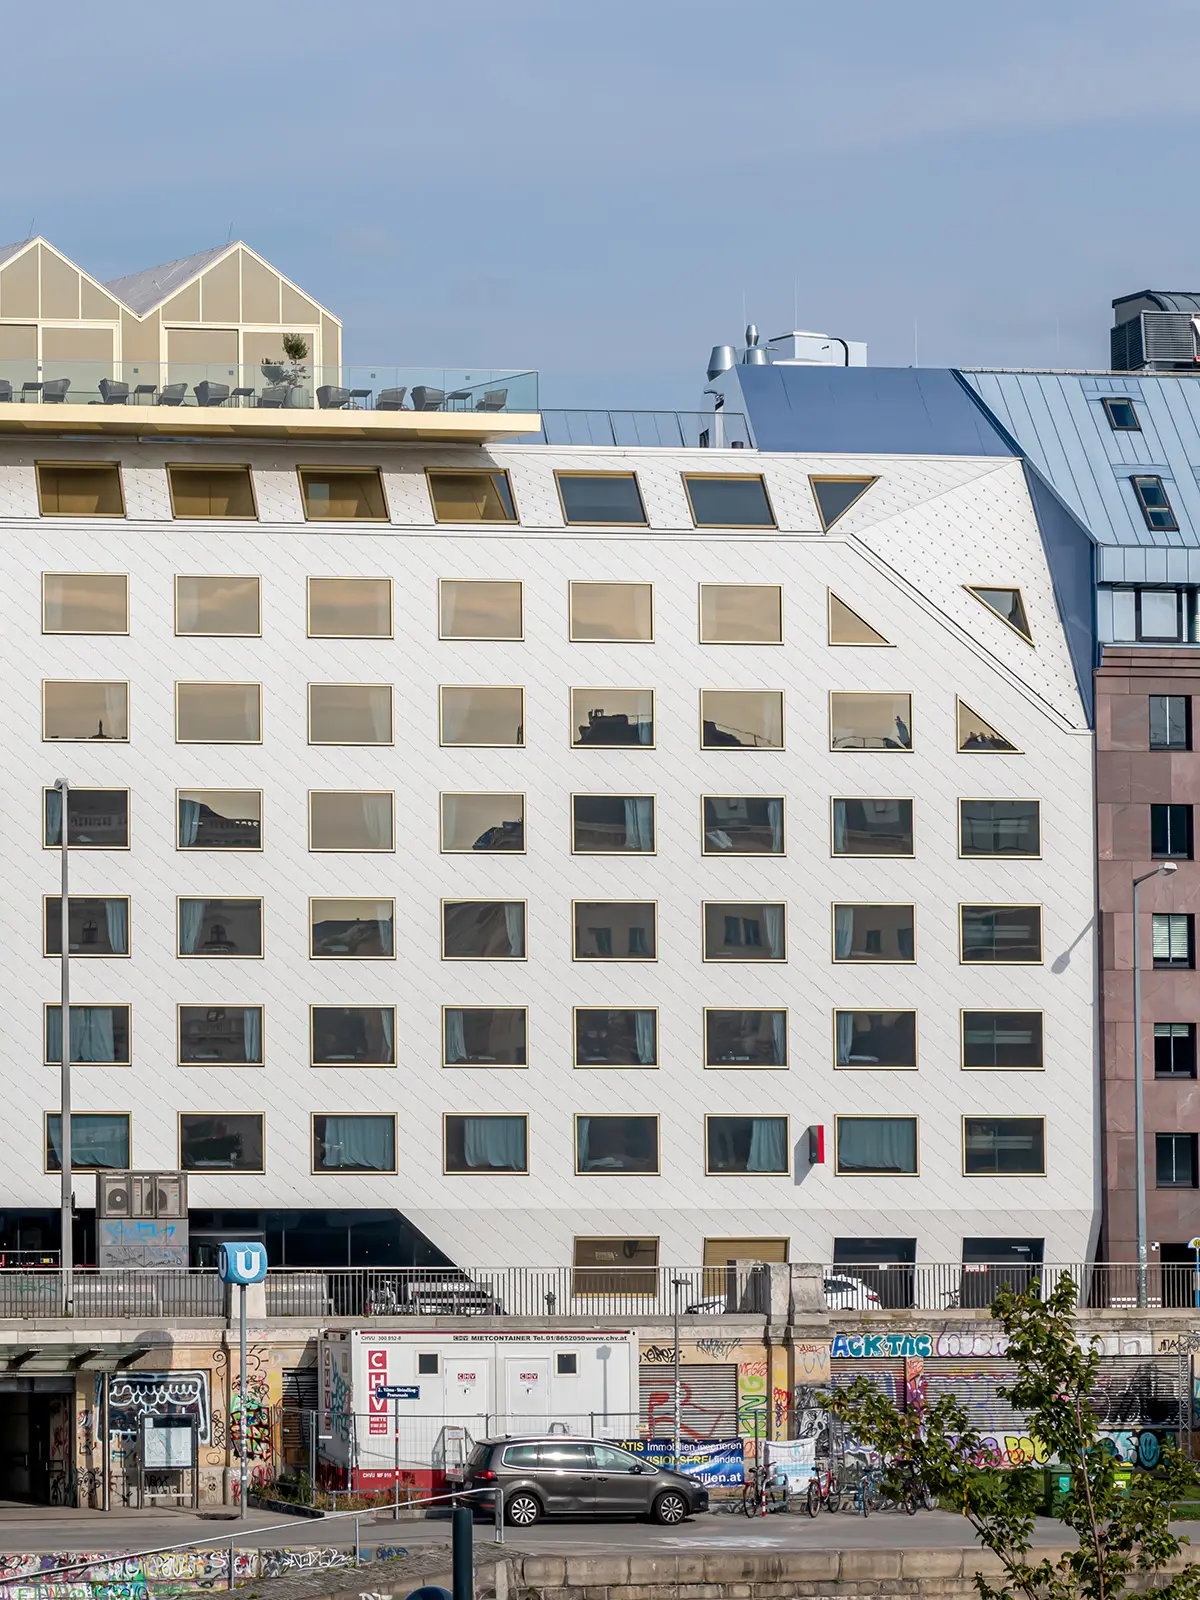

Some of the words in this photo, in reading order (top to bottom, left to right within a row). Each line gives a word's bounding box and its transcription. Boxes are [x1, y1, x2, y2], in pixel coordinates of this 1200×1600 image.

[236, 1249, 261, 1279] U
[369, 1352, 387, 1412] CHV
[614, 1442, 644, 1452] ATIS
[648, 1442, 695, 1452] Immoblien
[641, 1455, 711, 1465] VISIONSFREI
[714, 1455, 742, 1464] finden
[692, 1472, 742, 1484] bilien.at
